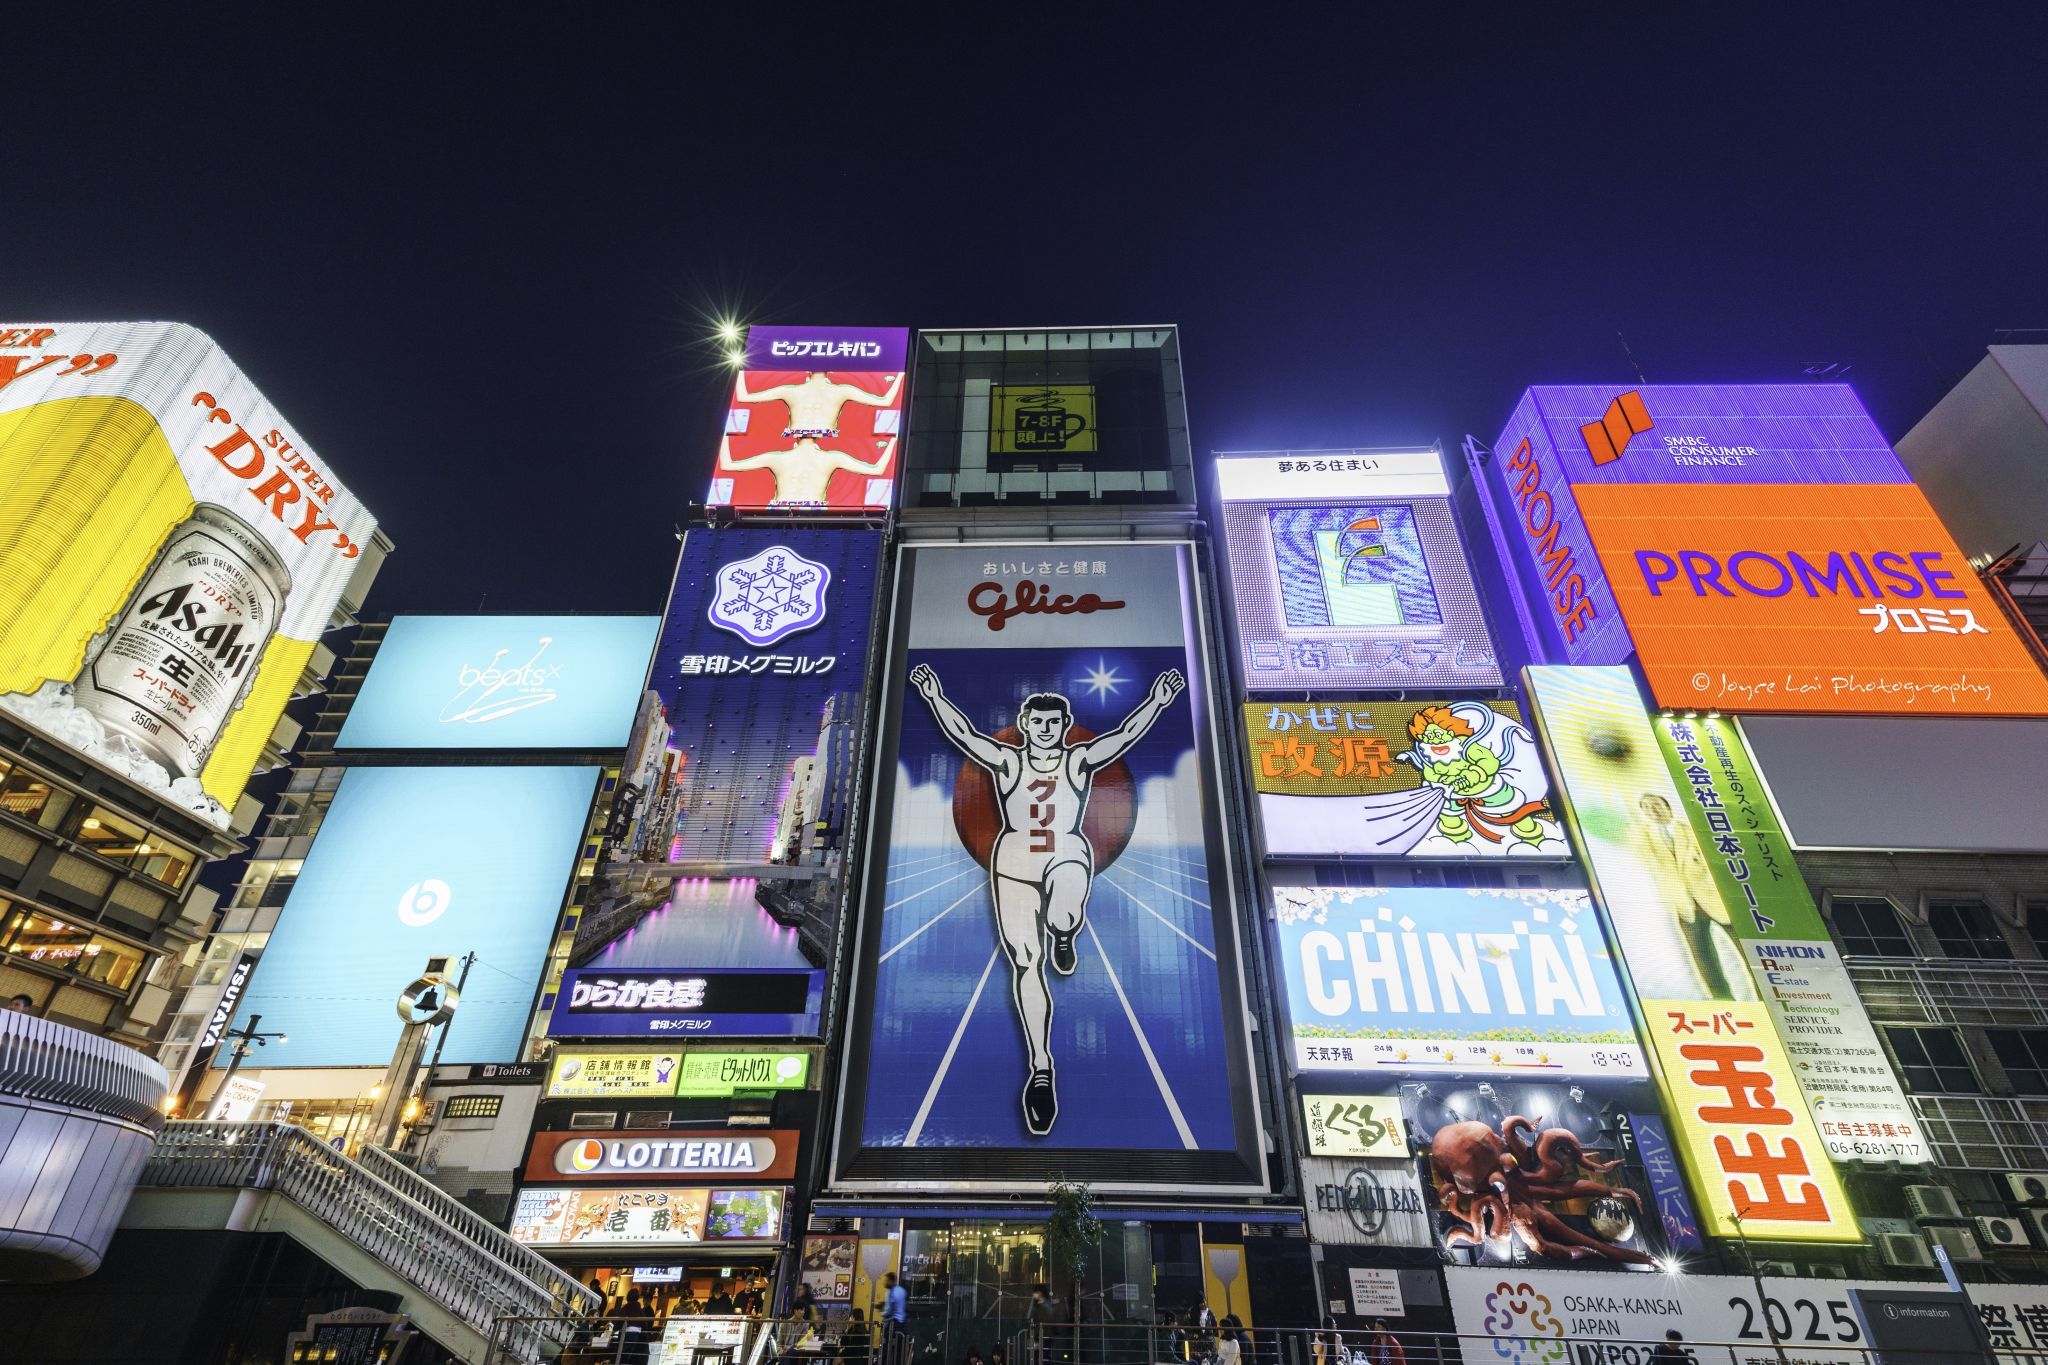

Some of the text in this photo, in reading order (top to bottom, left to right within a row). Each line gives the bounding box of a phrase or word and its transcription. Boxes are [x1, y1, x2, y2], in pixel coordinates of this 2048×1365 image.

[771, 340, 880, 357] ピップエレキバン
[1019, 415, 1062, 427] 7-8F
[1017, 431, 1065, 444] 頭上!
[1664, 436, 1708, 447] SMBC
[1669, 447, 1759, 456] CONSUMER
[1674, 456, 1747, 467] FINANCE
[262, 429, 335, 505] SUPER
[1278, 460, 1379, 473] 夢ある住まい
[1507, 437, 1597, 644] PROMISE
[983, 561, 1107, 576] おいしさと健康
[1635, 551, 1968, 599] PROMISE
[188, 557, 209, 568] ASAHI
[213, 557, 249, 590] BREWERIES
[246, 590, 258, 621] LIMITED
[967, 580, 1126, 631] Glico
[1858, 604, 1990, 634] プロミス
[140, 583, 255, 678] Asahi
[680, 655, 836, 674] 雪印メグミルク
[1249, 639, 1496, 671] 日商エステム
[159, 654, 194, 688] 生
[133, 667, 197, 714] スーパードライ
[131, 710, 162, 736] 350ml
[1265, 706, 1375, 732] かぜに
[1257, 737, 1394, 778] 改源
[1704, 725, 1783, 881] 不動産再生のスペシャリスト
[1026, 776, 1058, 852] グリコ
[1669, 722, 1775, 934] 株式会社日本リート
[1300, 907, 1606, 1016] CHINTAI
[1756, 945, 1826, 959] NIHON
[1761, 959, 1795, 972] Real
[1767, 973, 1809, 986] Estate
[1772, 986, 1832, 1000] Investment
[201, 963, 251, 1048] TSUTAYA
[1776, 1000, 1840, 1015] Technology
[650, 1020, 711, 1029] 雪印メグミルク
[1667, 1011, 1754, 1035] スーパー
[1784, 1016, 1829, 1024] SERVICE
[1788, 1026, 1843, 1034] PROVIDER
[1307, 1046, 1353, 1061] 天気予報
[498, 1066, 531, 1076] Toilets
[585, 1060, 651, 1070] 店舗情報館
[720, 1058, 771, 1082] ピタットハウス
[1815, 1066, 1885, 1074] 全日本不動産協会
[1325, 1103, 1386, 1147] くくる
[1616, 1114, 1633, 1150] 2F
[1680, 1044, 1831, 1221] 玉出
[1823, 1122, 1912, 1137] 広告主募集中
[609, 1142, 755, 1167] LOTTERIA
[1830, 1142, 1919, 1156] 06-6281-1717
[1640, 1125, 1688, 1237] ペンギンバー
[619, 1193, 668, 1206] たこやき
[1390, 1186, 1423, 1215] BAR
[650, 1208, 670, 1231] 番
[835, 1283, 848, 1297] 8F
[1563, 1296, 1682, 1315] OSAKA-KANSAI
[1899, 1308, 1950, 1318] information
[1571, 1318, 1621, 1335] JAPAN
[1728, 1297, 1861, 1342] 2025
